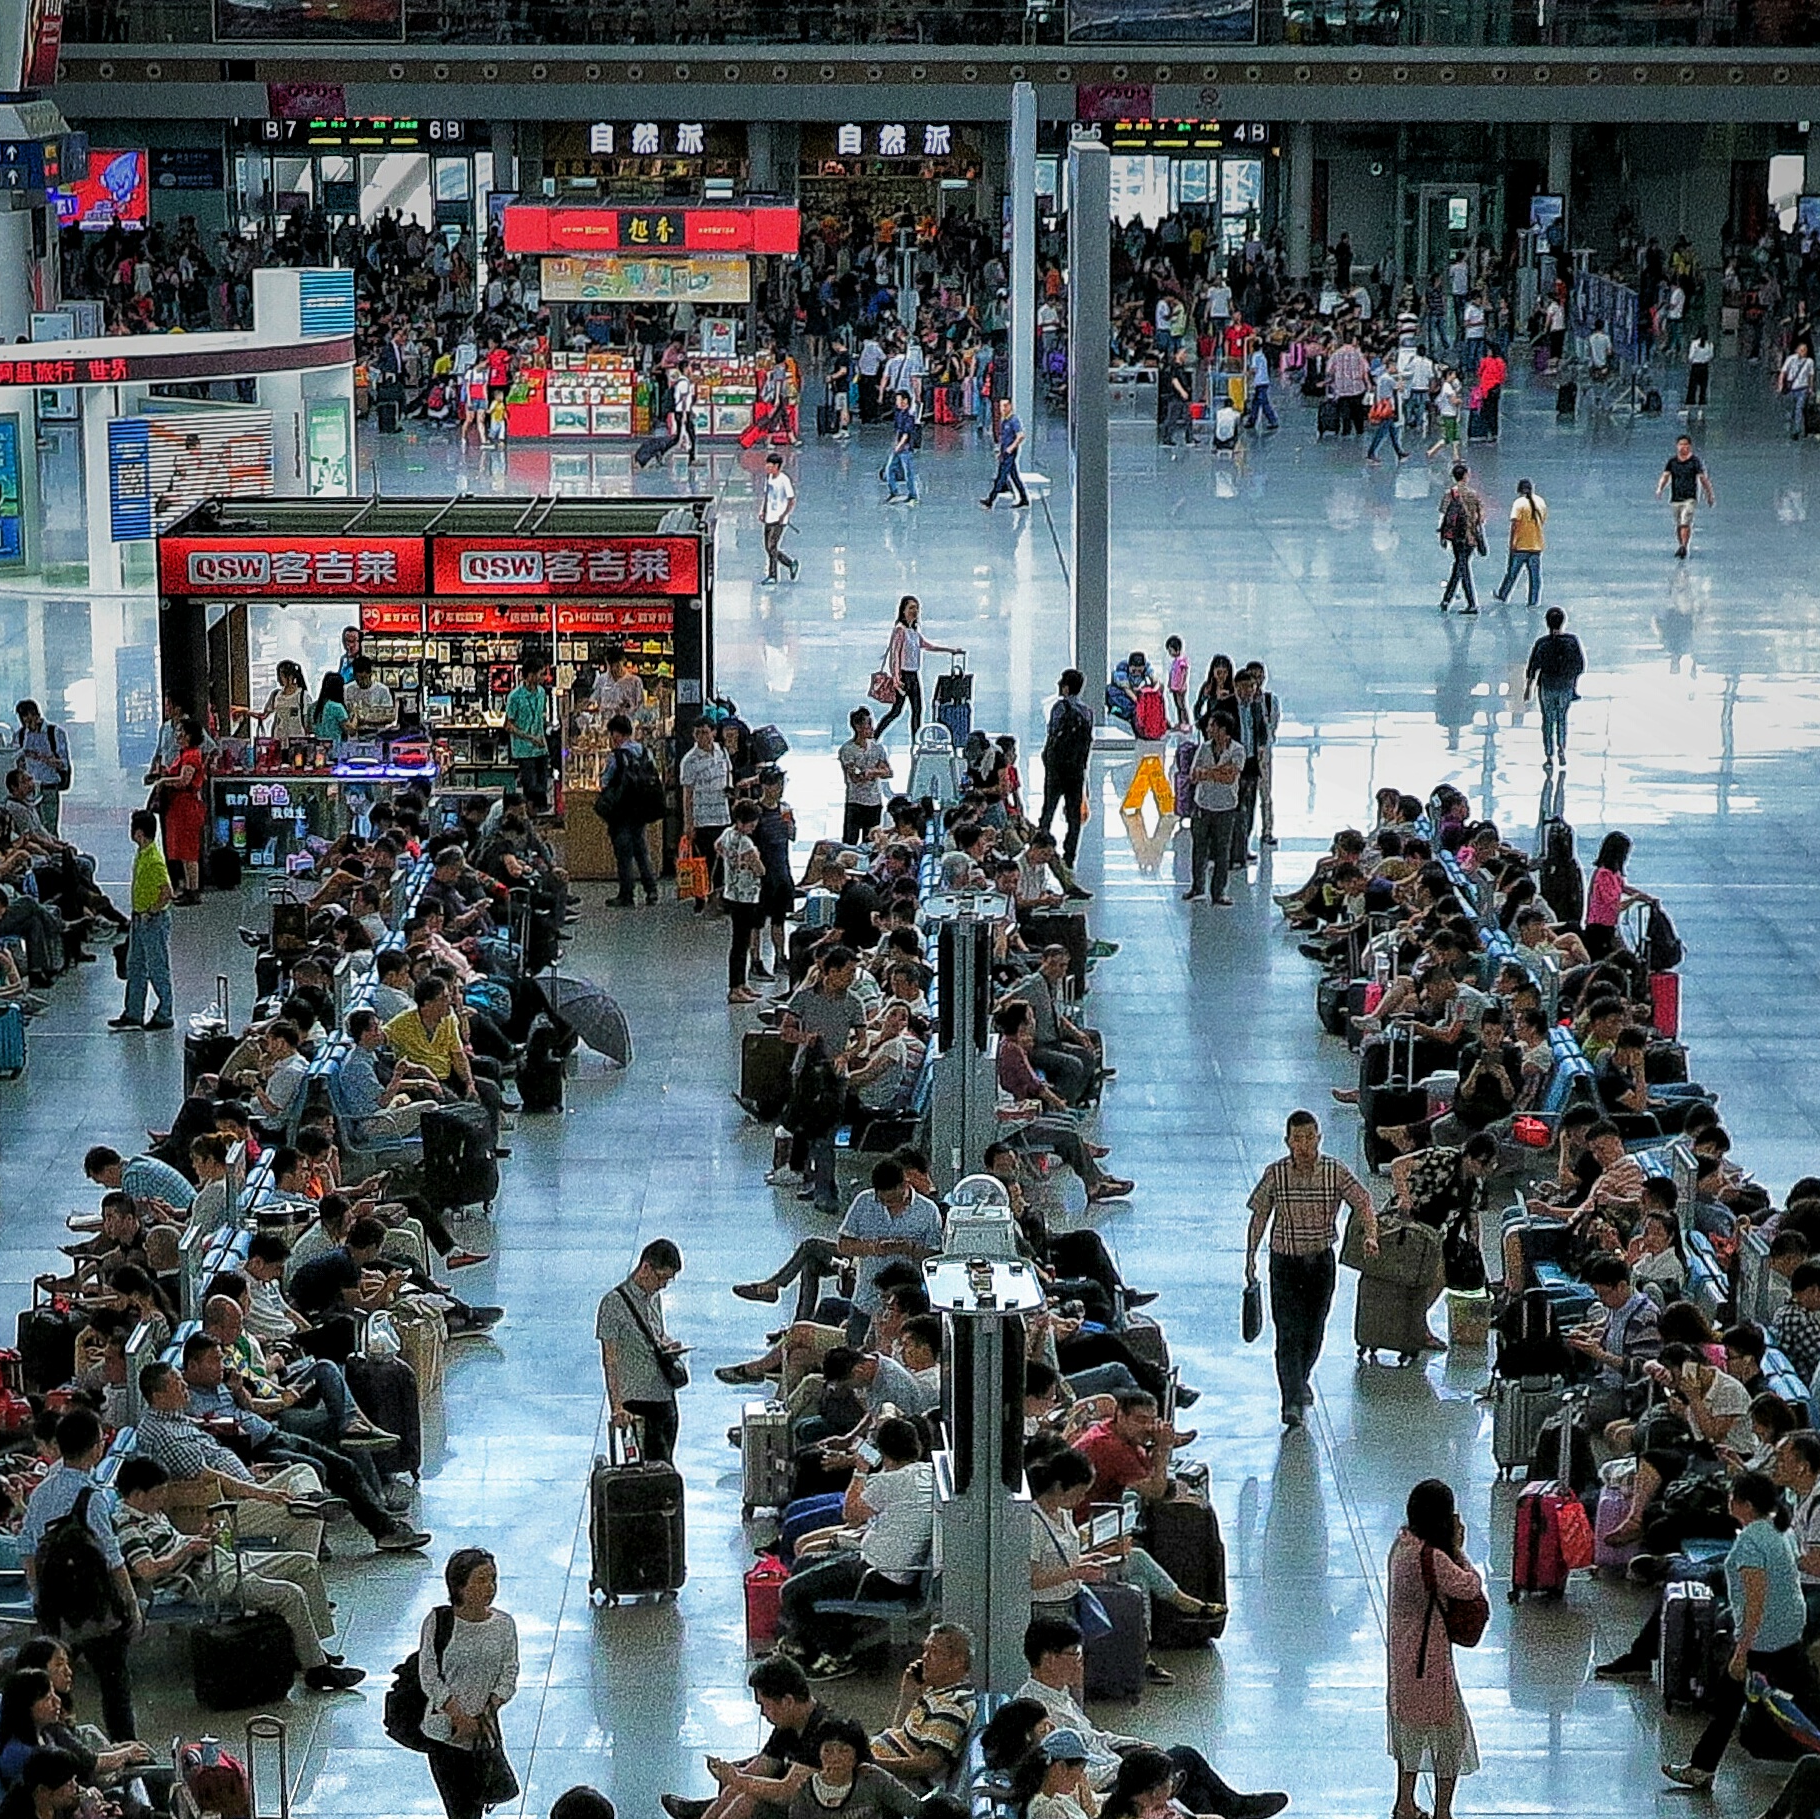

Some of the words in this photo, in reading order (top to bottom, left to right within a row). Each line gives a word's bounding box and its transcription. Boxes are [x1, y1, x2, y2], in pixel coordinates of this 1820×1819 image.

[590, 123, 704, 154] 自然派
[838, 123, 951, 155] 自然派
[88, 359, 129, 382] 世界
[197, 555, 263, 580] QSW
[270, 551, 398, 584] 客吉莱
[469, 555, 539, 580] QSW
[544, 551, 672, 584] 客吉莱
